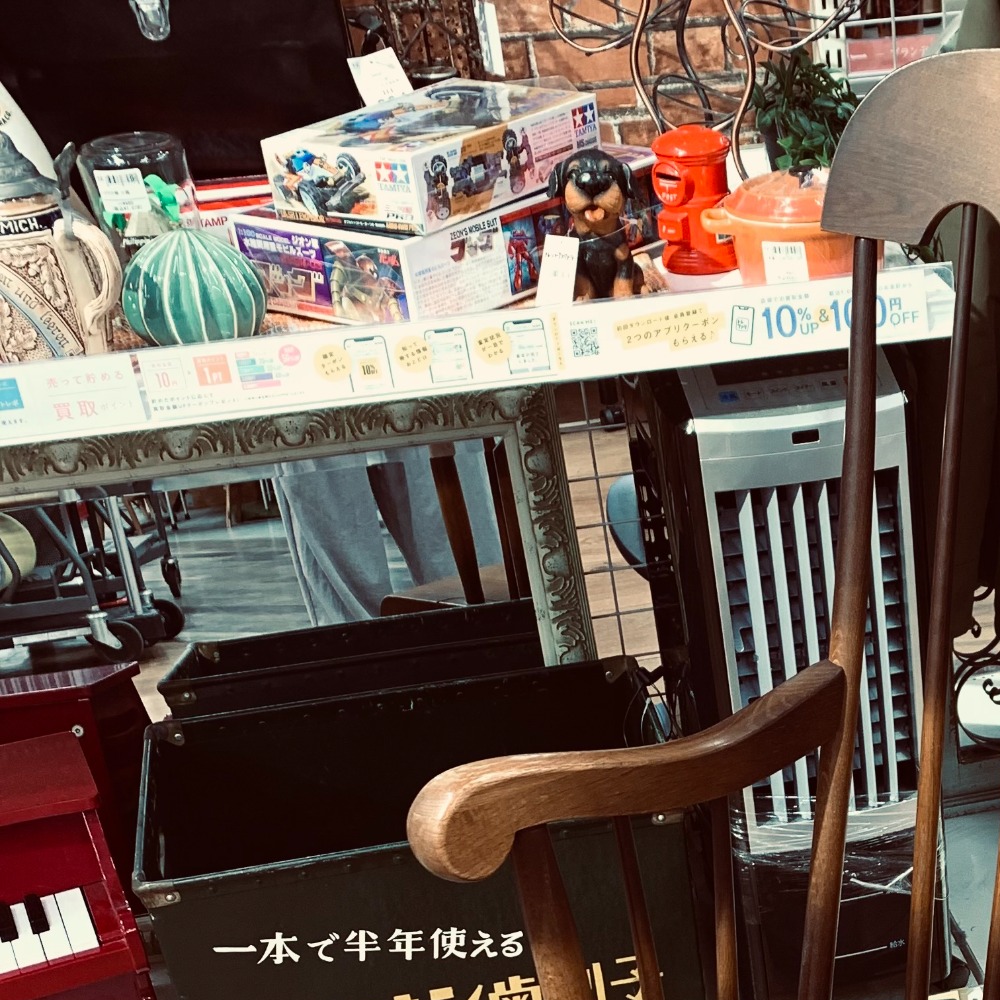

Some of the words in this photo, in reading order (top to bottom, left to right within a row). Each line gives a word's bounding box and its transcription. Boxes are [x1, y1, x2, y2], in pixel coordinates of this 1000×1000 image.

[574, 124, 597, 137] TAMIYA
[378, 183, 412, 193] TAMIYA
[468, 222, 487, 234] MOBILE
[487, 217, 498, 229] SUIT
[626, 316, 720, 344] 2つのアプリクーポン
[799, 322, 820, 336] UP
[889, 310, 920, 327] OFF
[212, 927, 524, 964] 一本で半年使える
[889, 938, 906, 949] 給水
